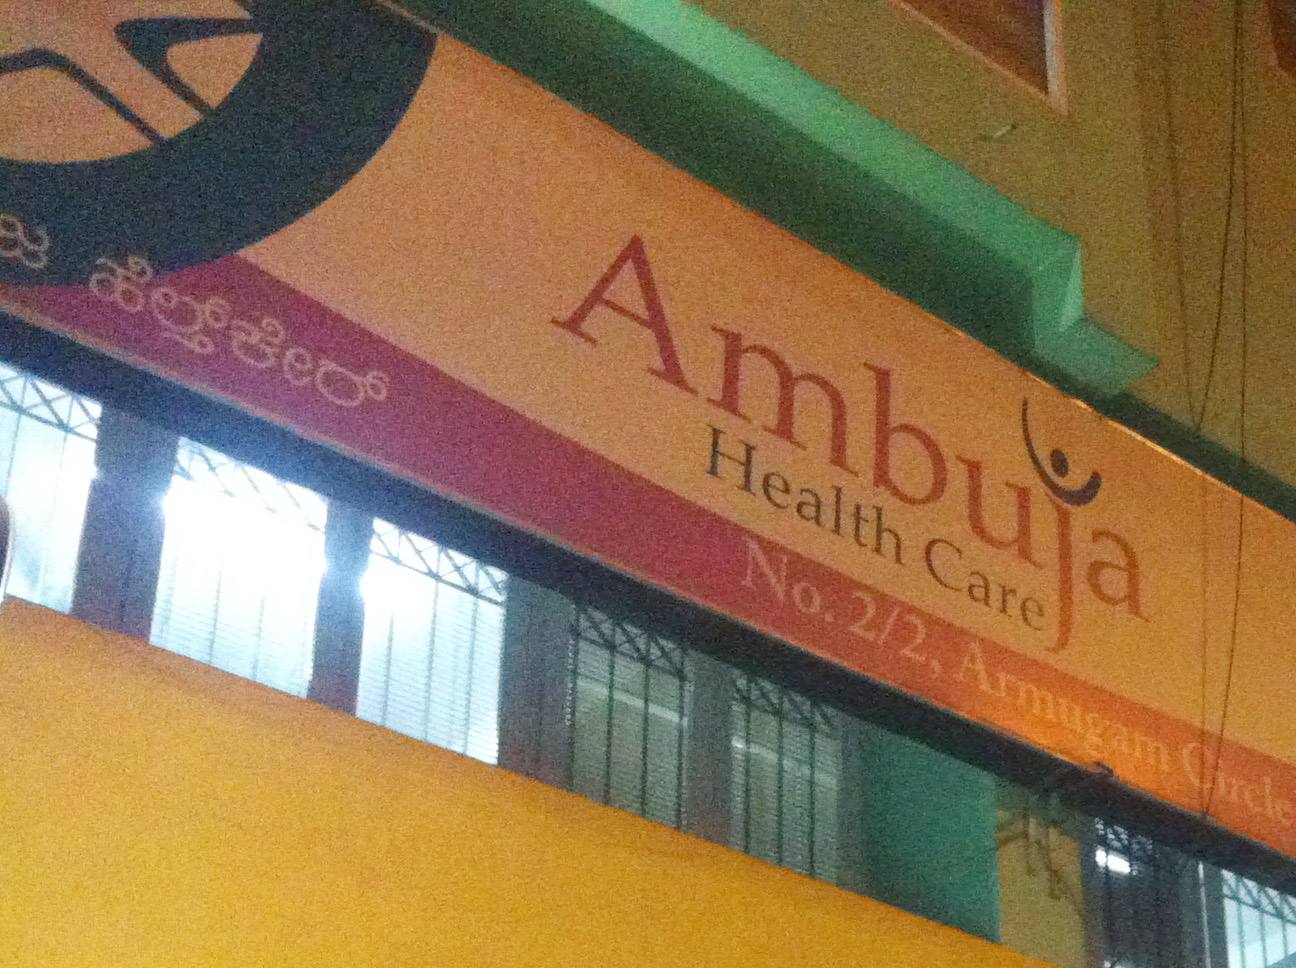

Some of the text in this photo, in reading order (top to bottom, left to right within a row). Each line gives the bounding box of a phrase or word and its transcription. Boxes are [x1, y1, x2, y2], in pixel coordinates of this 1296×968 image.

[551, 234, 1151, 651] Ambuja
[704, 424, 1047, 631] Health Care
[740, 538, 836, 622] No.
[849, 593, 944, 679] 2/2,
